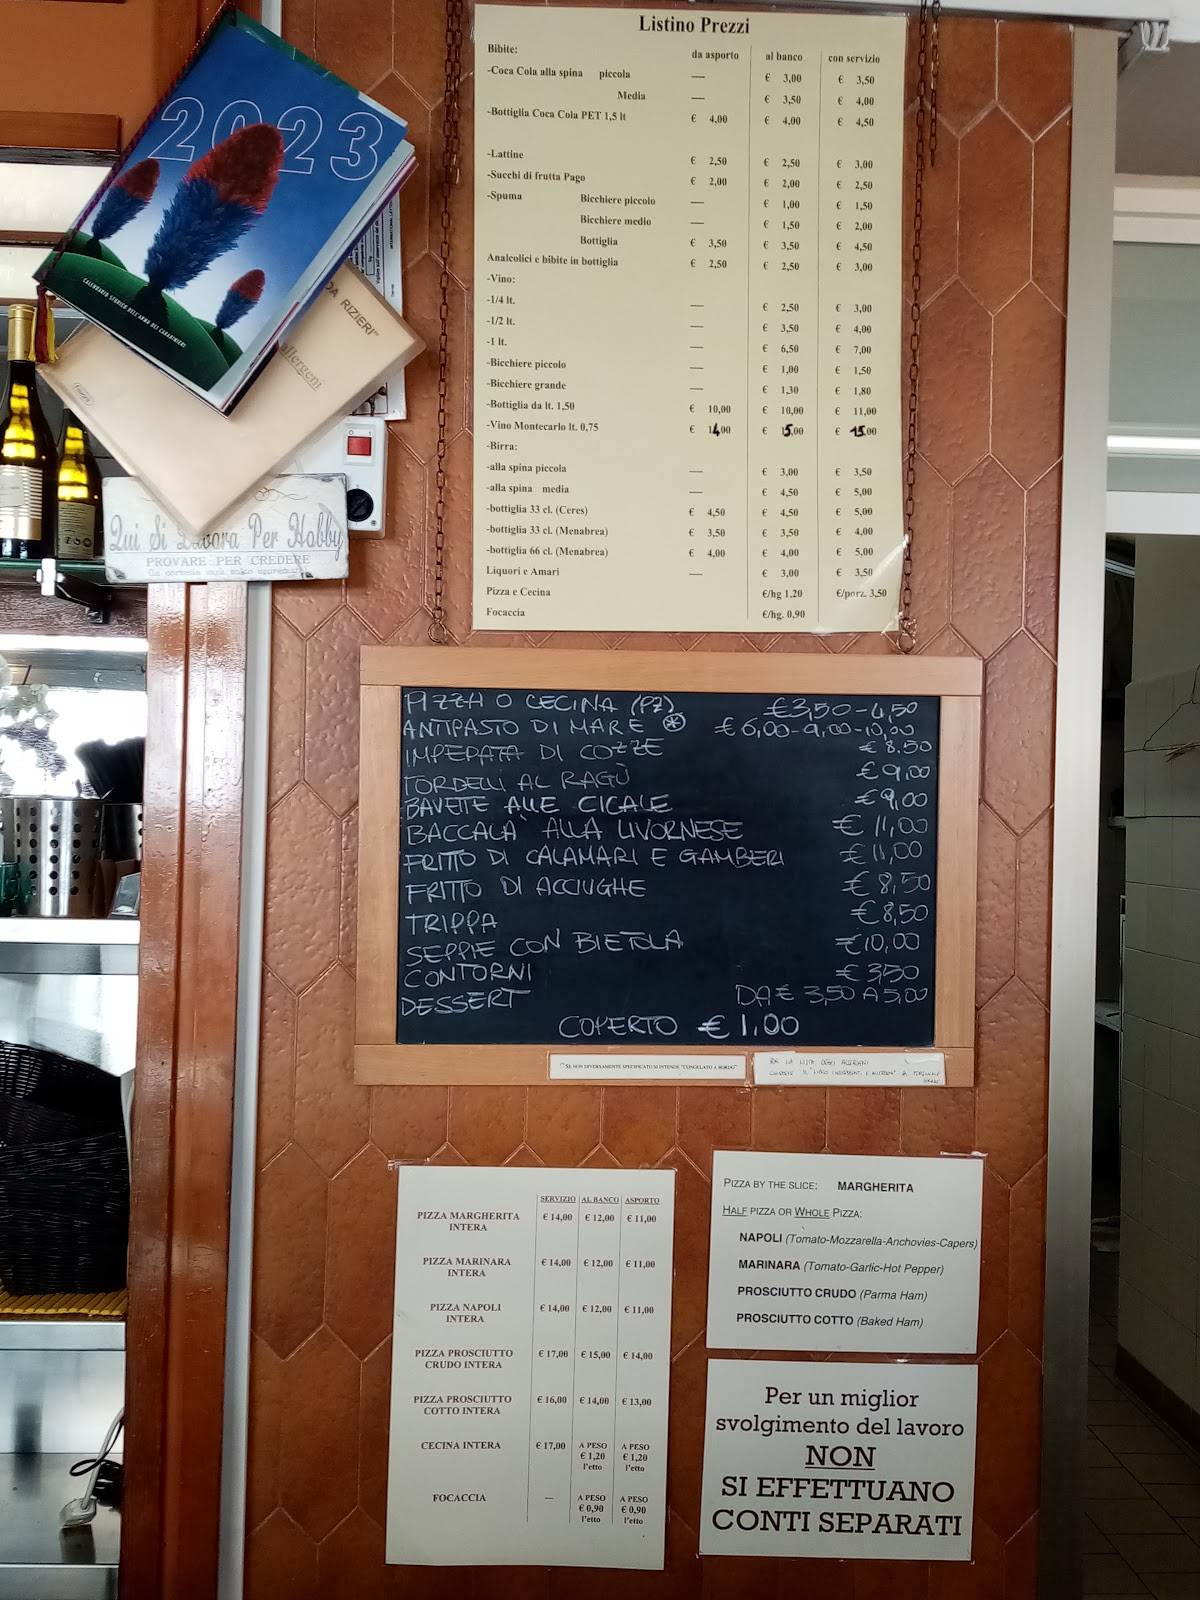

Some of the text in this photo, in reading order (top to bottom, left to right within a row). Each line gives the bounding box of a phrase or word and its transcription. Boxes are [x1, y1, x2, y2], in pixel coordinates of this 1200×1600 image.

[639, 15, 749, 34] Listino Prezzi
[488, 44, 517, 54] Bibite:
[692, 50, 739, 62] da asporto
[766, 51, 802, 61] al banco
[846, 54, 880, 64] servizio
[516, 66, 537, 76] Cola
[540, 67, 556, 76] alla
[559, 68, 583, 79] spina
[600, 68, 630, 80] piccola
[524, 171, 532, 180] di
[535, 172, 560, 180] frutta
[564, 172, 585, 184] Pago
[487, 253, 532, 263] Analcolici
[542, 255, 567, 264] bibite
[570, 256, 578, 265] in
[582, 256, 618, 268] bottiglia
[514, 422, 566, 431] Montecarlo
[568, 422, 578, 431] lt.
[580, 423, 598, 432] 0,75
[530, 505, 540, 514] 33
[542, 506, 552, 514] cl.
[556, 506, 588, 516] (Ceres)
[110, 514, 140, 551] Qui
[149, 515, 167, 551] Si
[248, 512, 279, 550] Per
[288, 512, 344, 562] Hobby
[146, 554, 310, 567] PROVARE PER CREDERE
[487, 566, 520, 576] Liquori
[531, 568, 559, 576] Amari
[487, 586, 510, 596] Pizza
[520, 587, 550, 596] Cecina
[486, 608, 525, 616] Focaccia
[787, 610, 805, 620] 0,90
[404, 690, 484, 714] PIZZA
[496, 694, 512, 708] O
[526, 694, 618, 712] CECINA
[400, 718, 644, 742] ANTIPASTO DI MARE
[540, 744, 563, 762] DI
[580, 738, 664, 760] COZZE
[404, 775, 506, 796] TORDELLI
[517, 774, 551, 791] AL
[404, 794, 673, 820] BAVETTE ALLE CICALE
[542, 816, 603, 840] ALLA
[618, 818, 743, 841] LIVORNESE
[403, 844, 784, 874] FRITTO DI CALAMARI E GAMBERI
[405, 876, 646, 904] FRITTO DI ACCIUGHE
[405, 910, 498, 935] TRIPPA
[406, 928, 684, 966] SEPPIE CON BIETOLA
[404, 962, 531, 988] CONTORNI
[401, 987, 531, 1016] DESSERT
[559, 1015, 678, 1038] COPERTO
[696, 1015, 729, 1038] €
[838, 1181, 914, 1192] MARGHERITA
[581, 1196, 620, 1205] AL BANCO
[450, 1212, 520, 1220] MARGHERITA
[552, 1214, 572, 1222] 14,00
[450, 1223, 488, 1231] INTERA
[740, 1232, 977, 1250] NAPOLI (Tomato-Mozzarella-Anchovies-Capers)
[456, 1258, 512, 1266] MARINARA
[739, 1260, 944, 1276] MARINARA (Tomato-Garlic-Hot Pepper)
[448, 1269, 486, 1277] INTERA
[738, 1286, 927, 1303] PROSCIUTTO CRUDO (Parma Ham)
[737, 1313, 923, 1329] PROSCIUTTO COTTO (Baked Ham)
[765, 1386, 919, 1412] Per un miglior
[716, 1414, 964, 1437] svolgimento del lavoro
[421, 1442, 460, 1450] CECINA
[805, 1445, 877, 1470] NON
[722, 1476, 954, 1502] SI EFFETTUANO
[433, 1494, 486, 1502] FOCACCIA
[712, 1509, 962, 1536] CONTI SEPARATI
